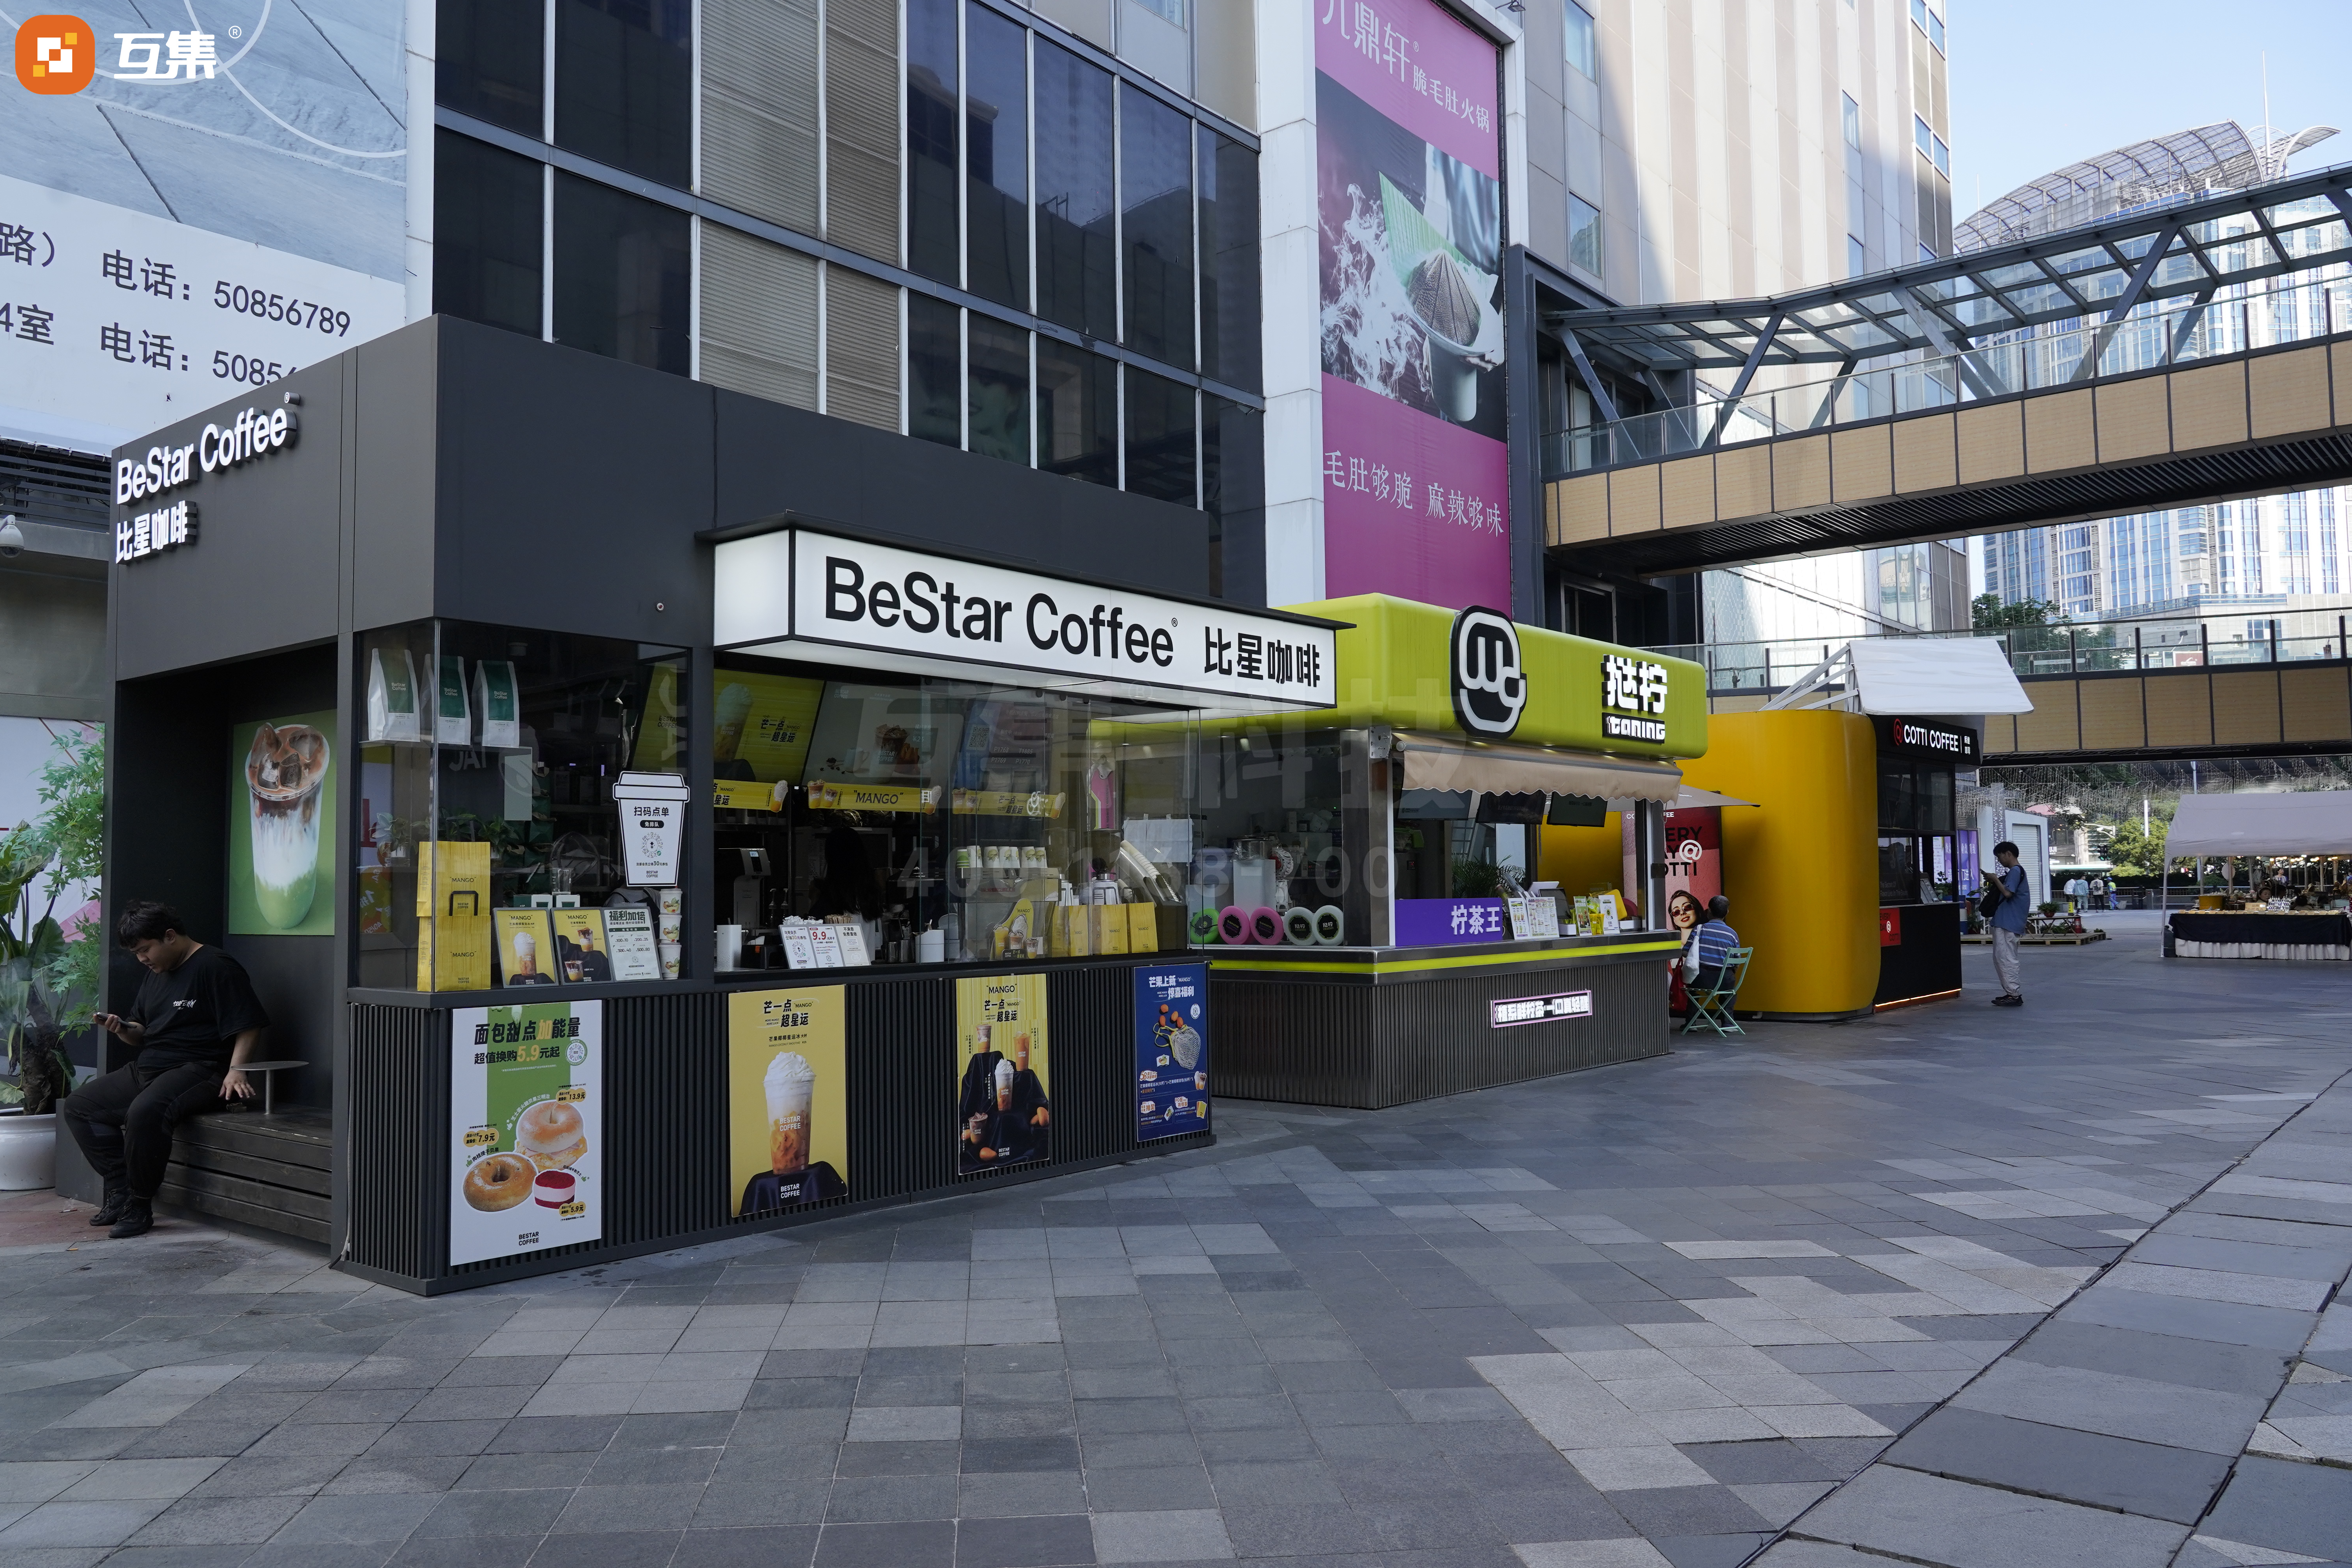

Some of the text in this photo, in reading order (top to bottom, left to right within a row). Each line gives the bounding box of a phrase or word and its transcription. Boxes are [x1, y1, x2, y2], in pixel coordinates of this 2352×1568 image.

[1413, 64, 1489, 133] 脆毛肚火锅
[116, 443, 194, 505] BeStar
[200, 407, 287, 473] Coffee
[1323, 450, 1504, 537] 毛肚够脆 麻辣够味
[116, 500, 188, 564] 比星咖啡
[826, 555, 1011, 643] BeStar
[1026, 592, 1174, 668] Coffee
[1203, 625, 1320, 688] 比星咖啡
[1904, 724, 1958, 752] COTTI COFFEE
[854, 789, 904, 804] "MANGO"
[634, 806, 669, 817] 扫码点单
[609, 911, 645, 924] 福利加倍
[1451, 904, 1501, 935] 柠茶王
[1149, 975, 1176, 988] 芒果上新
[986, 984, 1017, 994] "MANGO"
[1168, 986, 1194, 1000] 惊喜福利
[764, 999, 791, 1014] 芒一点
[984, 999, 1005, 1011] 芒一点
[781, 1013, 809, 1027] 超星运
[997, 1010, 1017, 1022] 超星运
[474, 1017, 581, 1045] 面包甜点加能量
[769, 1034, 800, 1042] 芒果椰椰星运冰
[474, 1045, 560, 1065] 超值换购5.9元起
[569, 1092, 585, 1100] 13.9元
[780, 1115, 800, 1124] BESTAR
[780, 1123, 801, 1131] COFFEE
[478, 1132, 495, 1143] 7.9元
[780, 1183, 800, 1192] BESTAR
[781, 1190, 800, 1198] COFFEE
[571, 1204, 584, 1213] 5.9元
[519, 1231, 539, 1240] BESTAR
[519, 1237, 539, 1246] COFFEE
